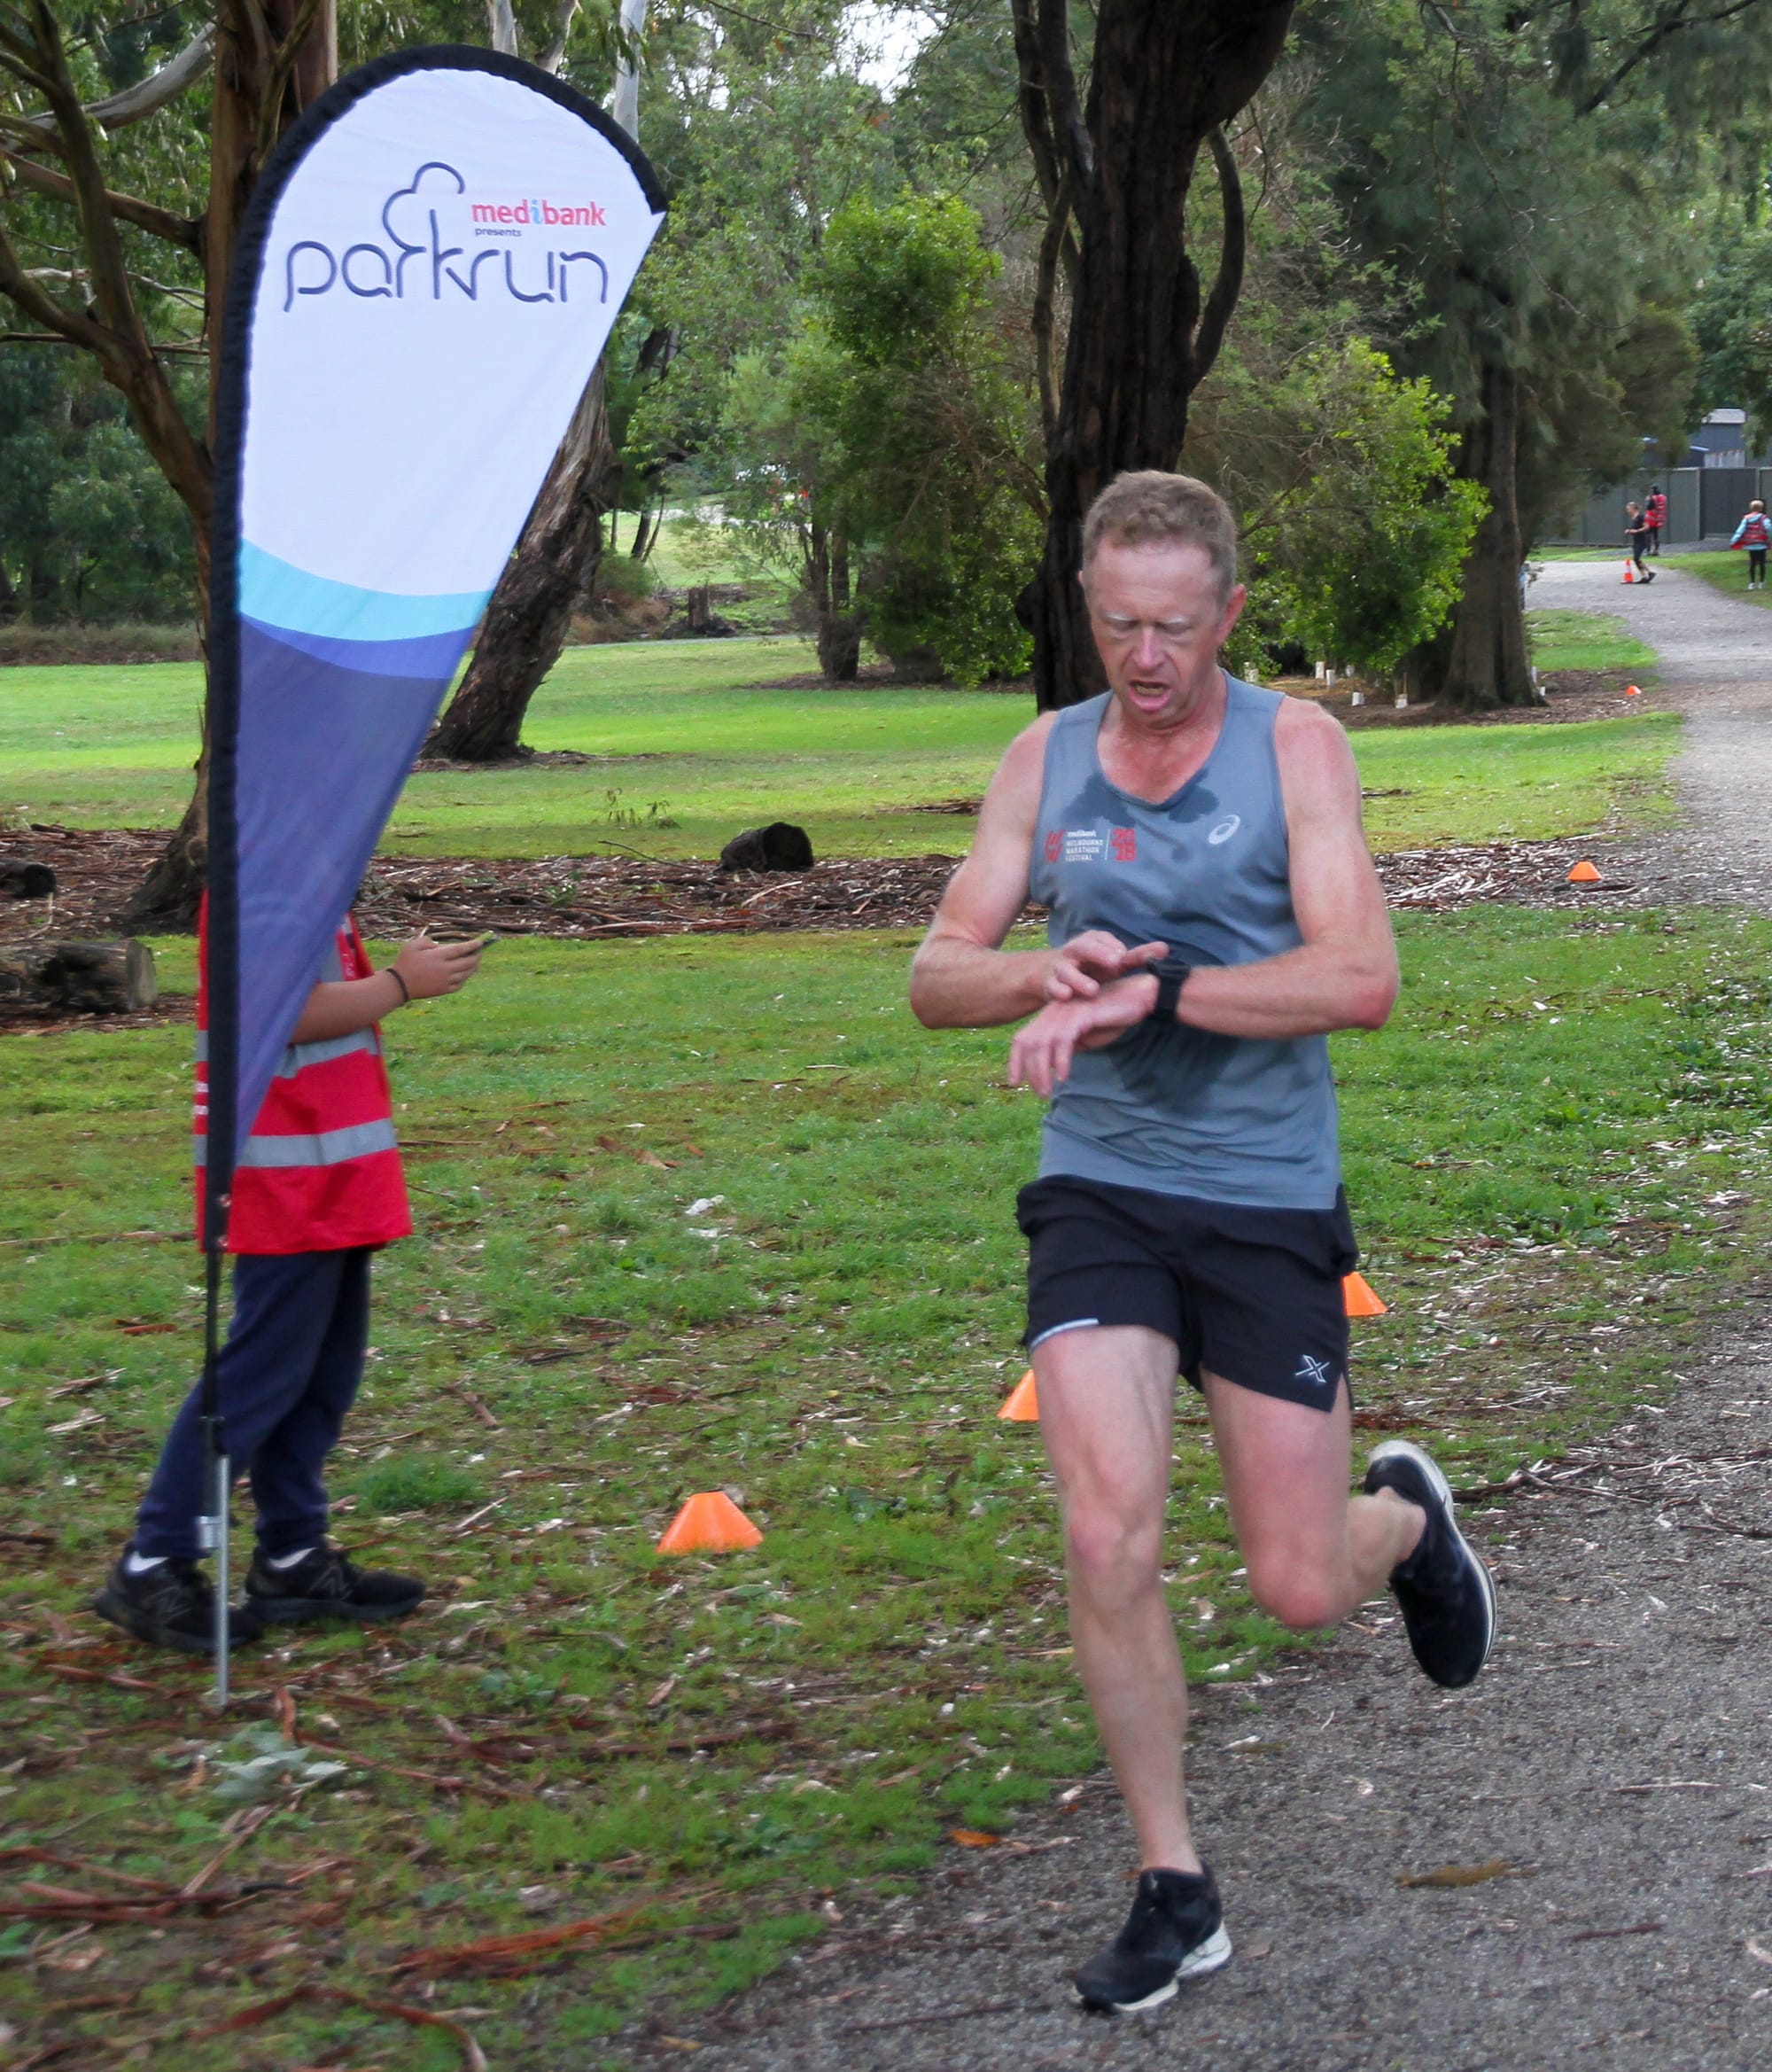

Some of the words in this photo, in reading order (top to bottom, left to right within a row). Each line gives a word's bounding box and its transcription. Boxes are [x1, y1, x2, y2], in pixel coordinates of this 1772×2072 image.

[471, 199, 607, 227] medibank
[474, 227, 523, 238] presents
[283, 207, 609, 313] parkrun
